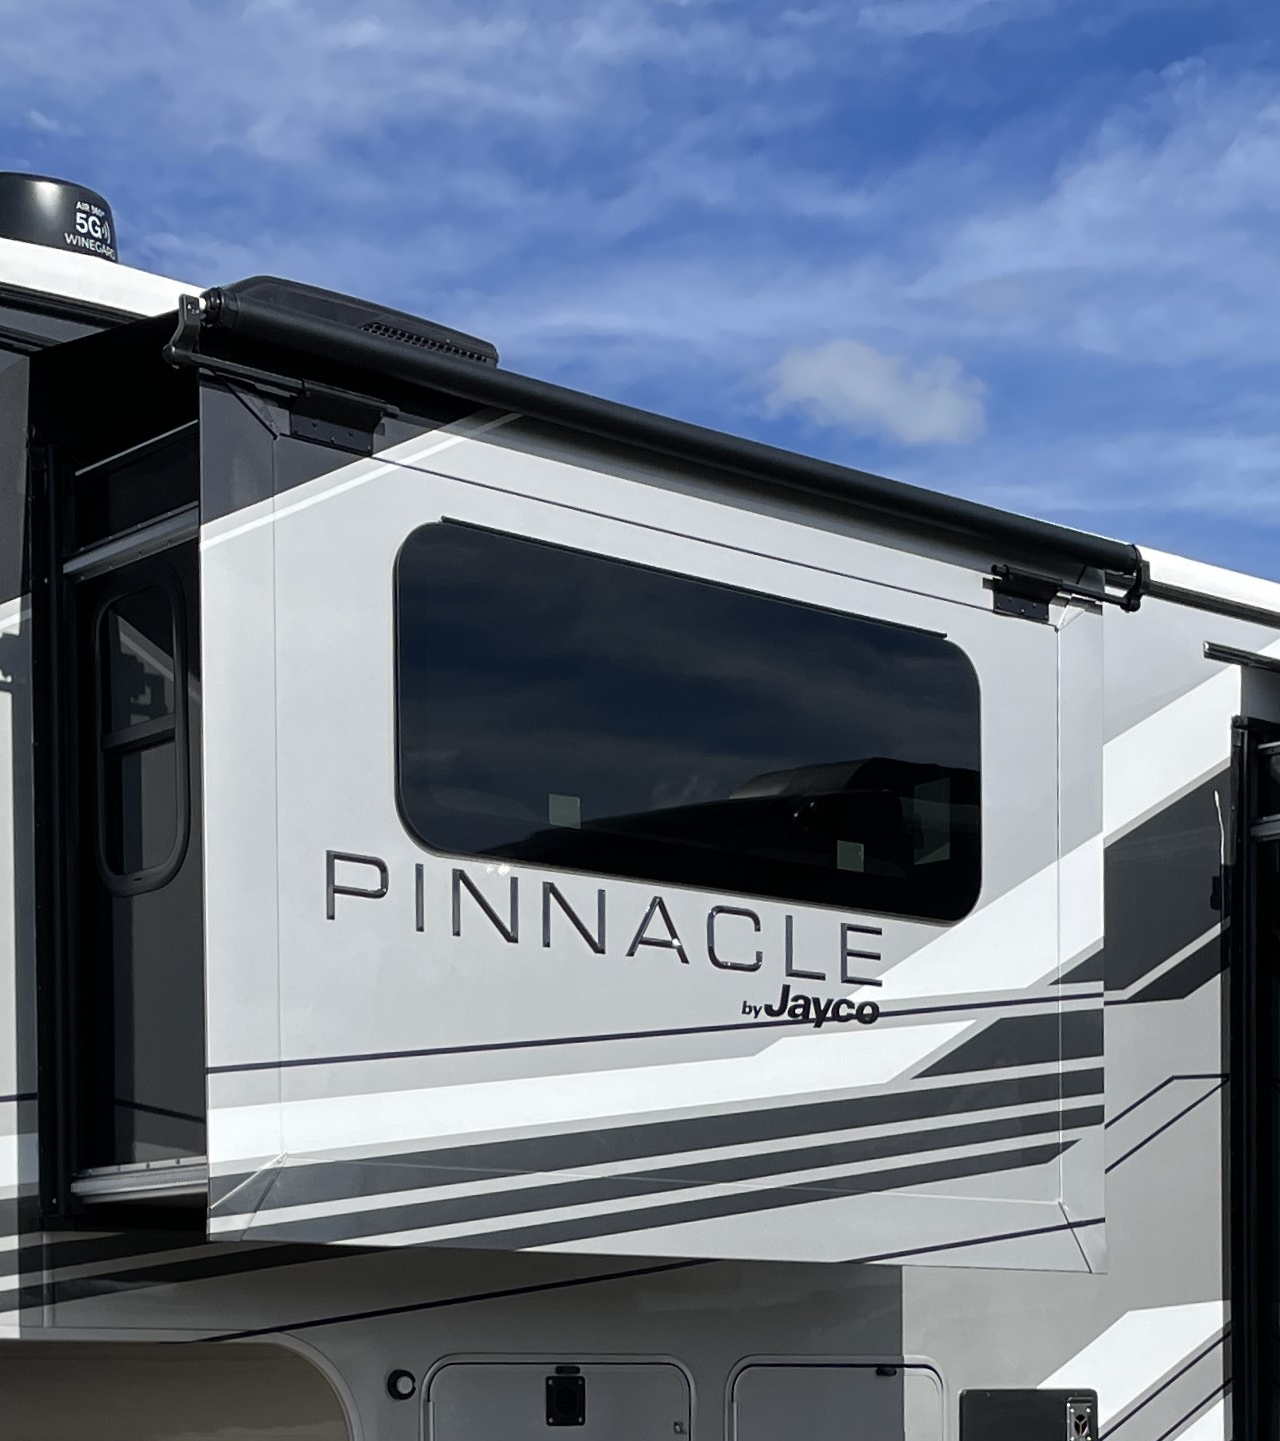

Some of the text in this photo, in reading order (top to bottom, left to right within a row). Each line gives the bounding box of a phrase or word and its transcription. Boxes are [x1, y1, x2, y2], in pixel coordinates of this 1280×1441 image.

[75, 211, 102, 239] 5G
[64, 232, 116, 260] WINEGARD
[325, 849, 884, 988] PINNACLE
[741, 983, 880, 1028] by Jayco
